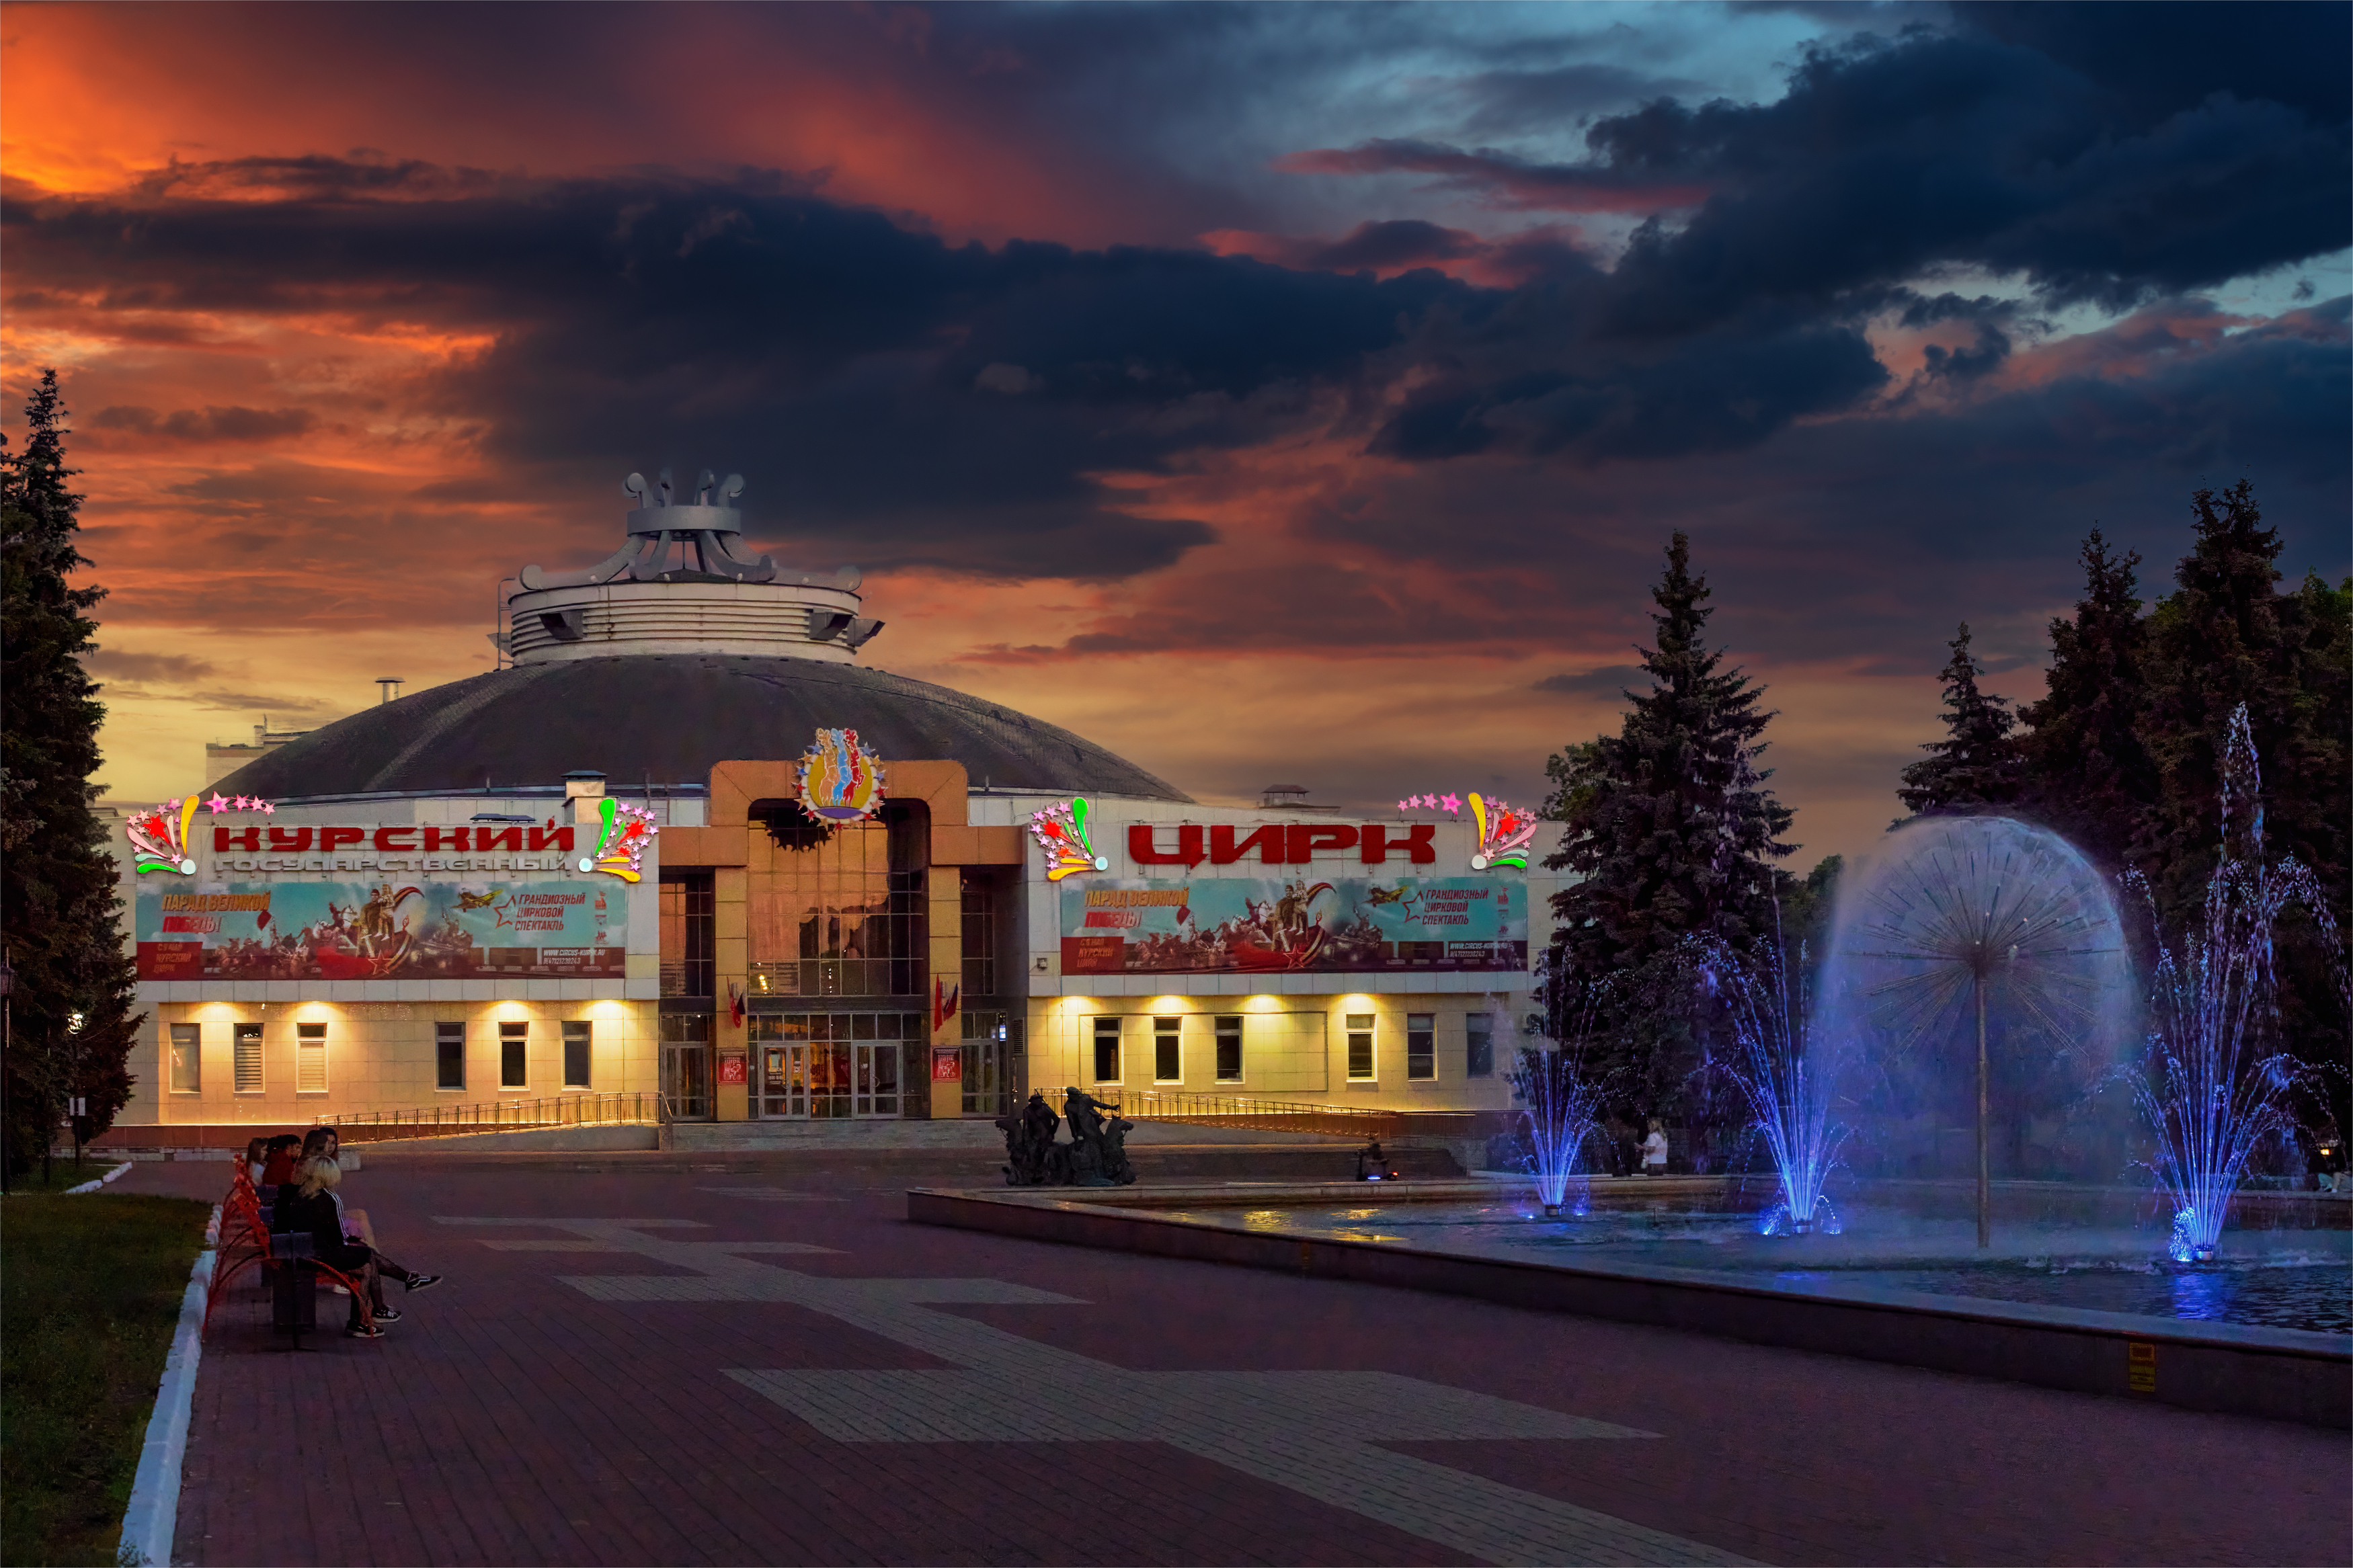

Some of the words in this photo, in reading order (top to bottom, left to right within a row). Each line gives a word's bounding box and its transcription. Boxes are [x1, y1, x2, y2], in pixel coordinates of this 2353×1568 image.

[214, 815, 574, 852] КУРСКИЙ
[1129, 825, 1435, 869] ЦИРК
[214, 854, 571, 871] ГОСУДАРСТВЕННЫЙ
[518, 893, 586, 905] ГРАНДИОЗНЫЙ
[1084, 890, 1127, 907] ПАРАД
[1129, 886, 1189, 907] ВЕЛИКОЙ
[1426, 887, 1489, 900] ГРАНДИОЗНЫЙ
[161, 893, 207, 912] ПАРАД
[208, 890, 271, 911] ВЕЛИКОЙ
[1424, 901, 1468, 913] ЦИРКОВОЙ
[516, 905, 564, 917] ЦИРКОВОЙ
[514, 920, 564, 930] СПЕКТАКЛЬ
[1422, 915, 1468, 925] СПЕКТАКЛЬ
